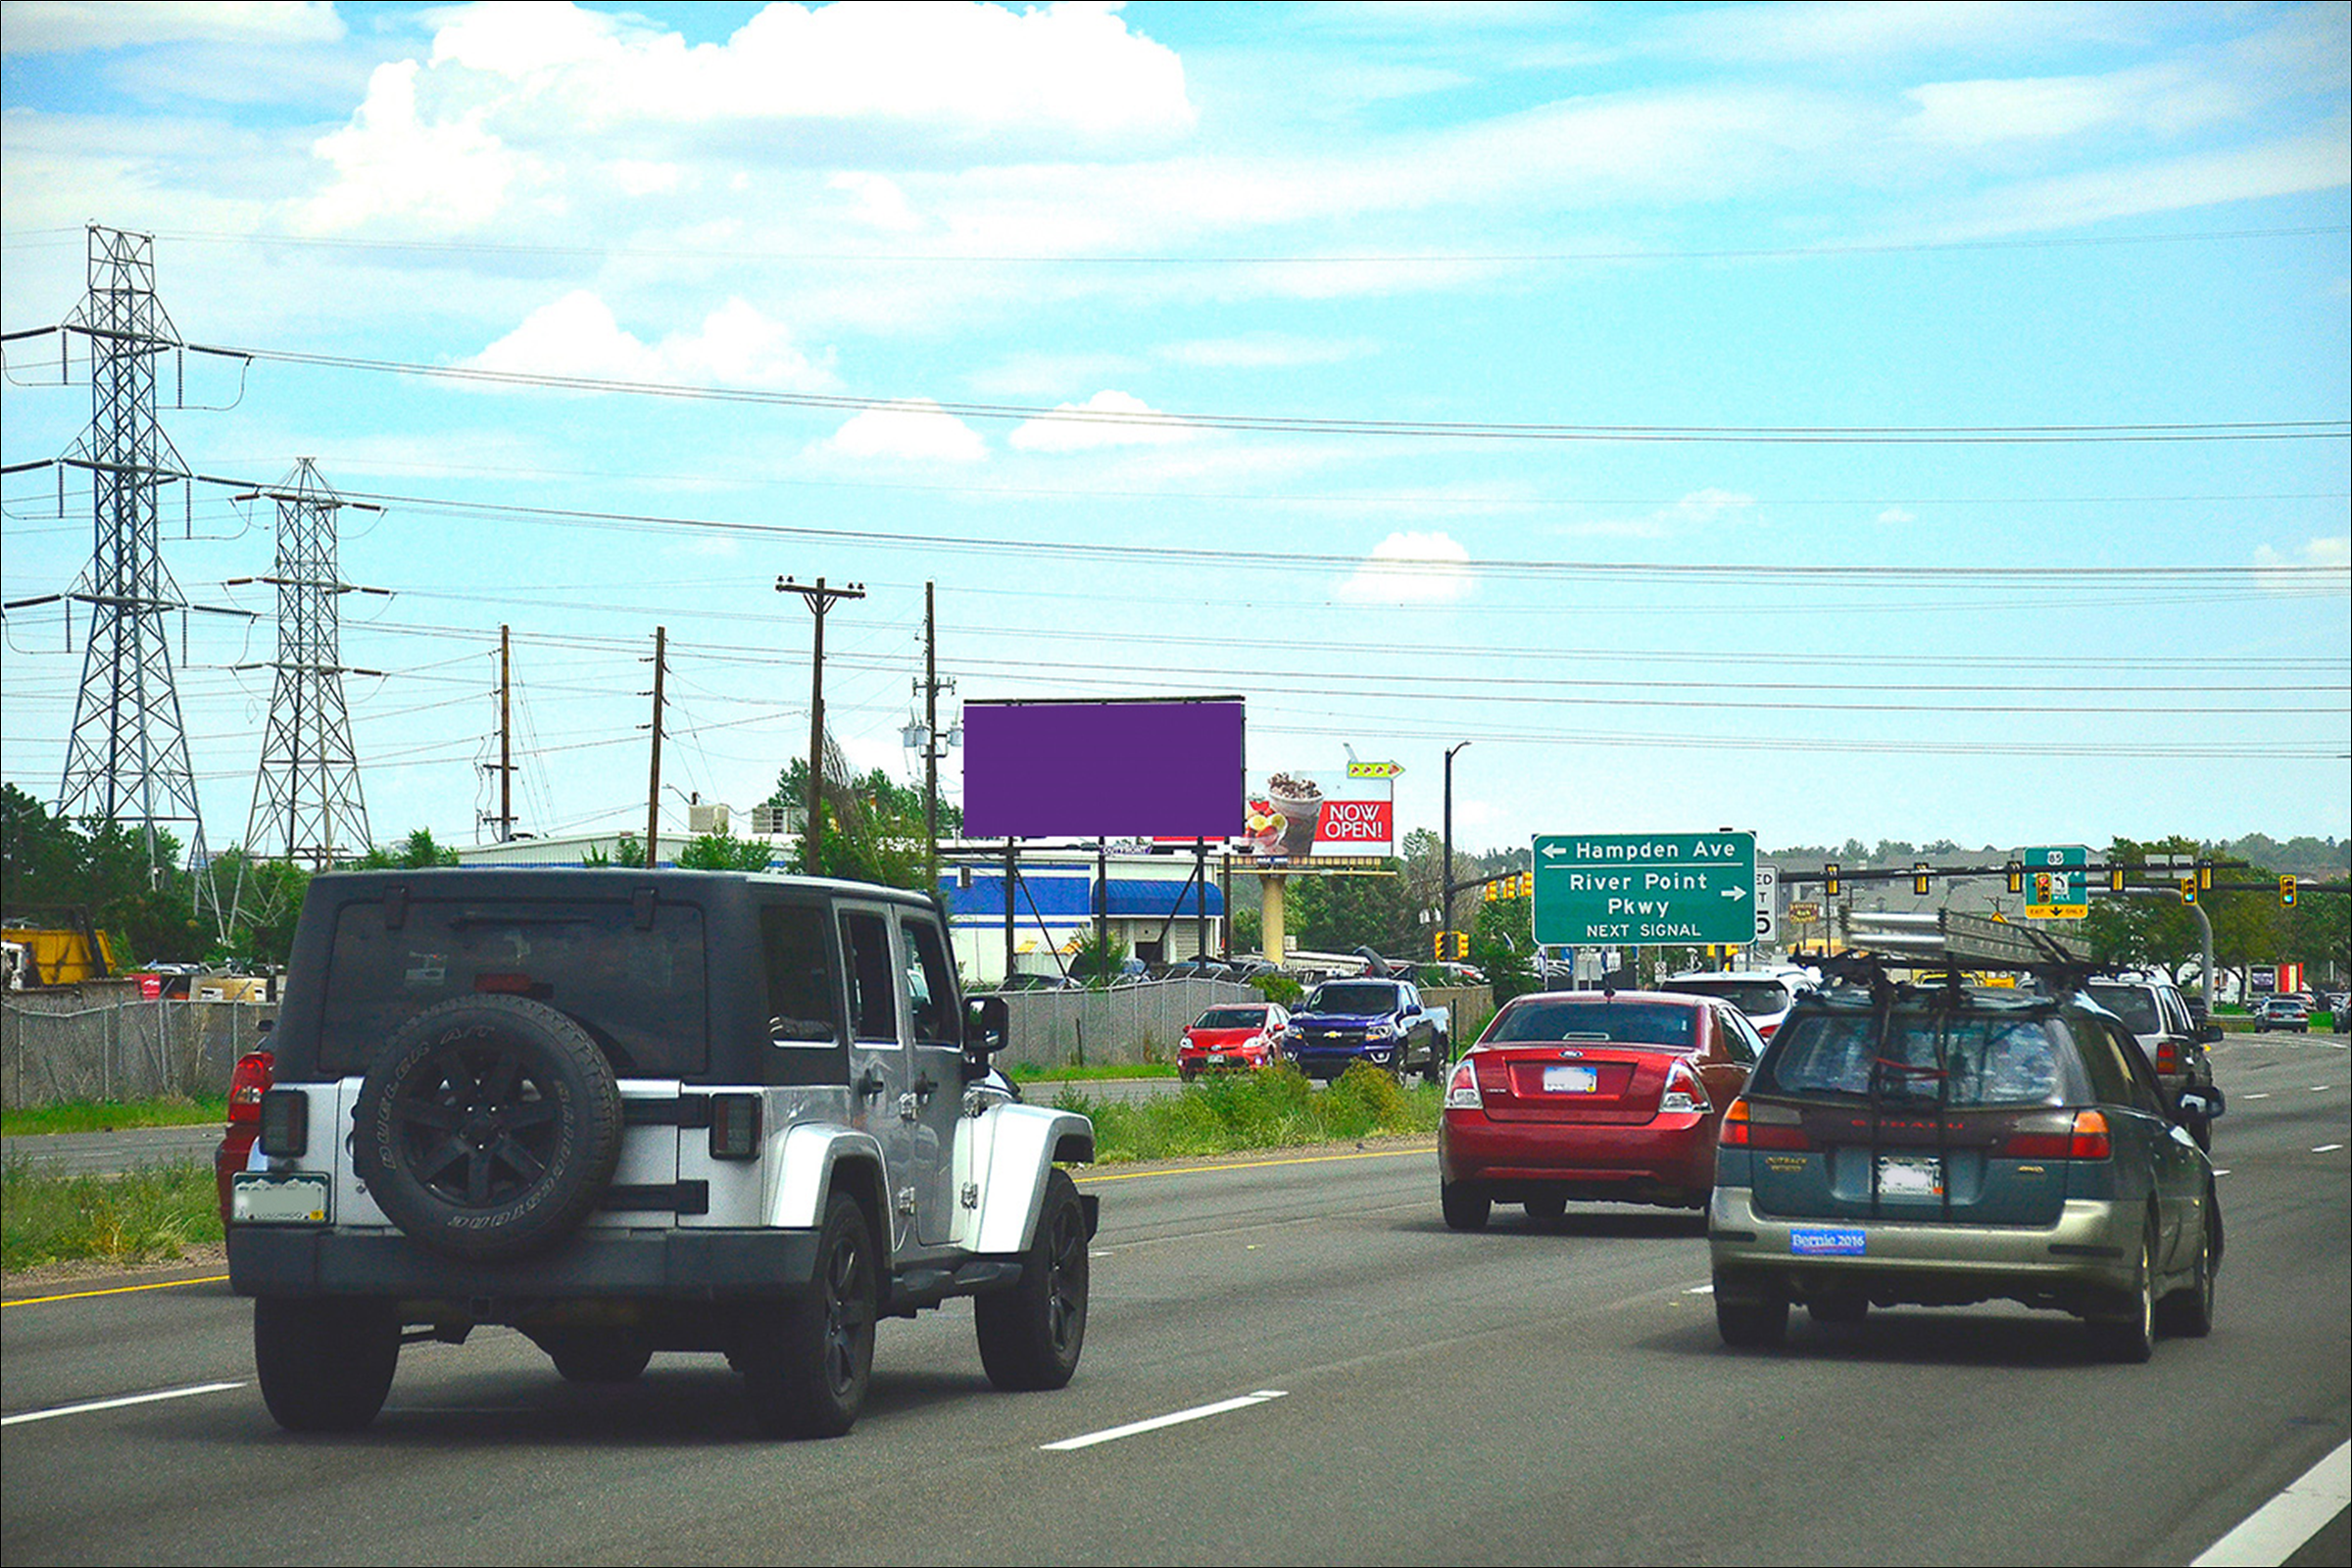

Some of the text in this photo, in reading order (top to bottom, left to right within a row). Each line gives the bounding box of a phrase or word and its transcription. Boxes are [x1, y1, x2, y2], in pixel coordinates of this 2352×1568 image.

[1330, 804, 1380, 821] NOW
[1325, 821, 1383, 839] OPEN!
[1576, 840, 1736, 861] Hampden Ave
[2048, 853, 2063, 863] 85
[1570, 872, 1707, 891] River Point
[1608, 897, 1670, 918] Pkwy
[1587, 922, 1702, 938] NEXT SIGNAL
[1756, 909, 1771, 934] 5
[1792, 1234, 1866, 1248] Bernie 2016
